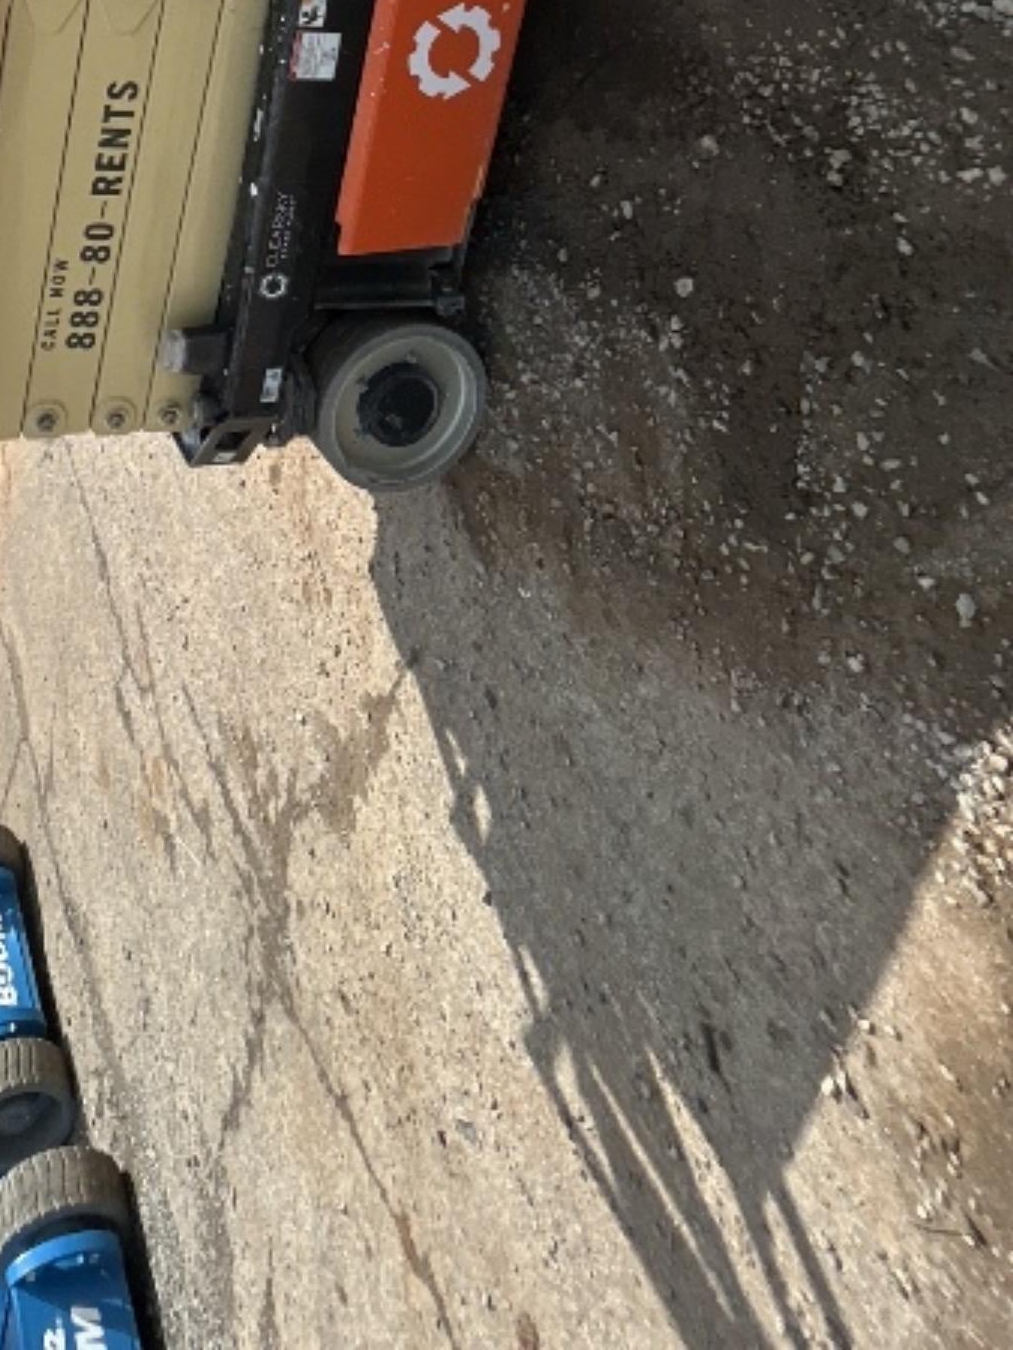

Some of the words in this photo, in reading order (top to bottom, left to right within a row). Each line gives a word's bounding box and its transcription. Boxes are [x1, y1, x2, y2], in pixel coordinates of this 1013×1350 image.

[64, 80, 139, 349] 888-80-RENTS
[49, 257, 69, 298] NOW
[40, 307, 61, 351] CALL
